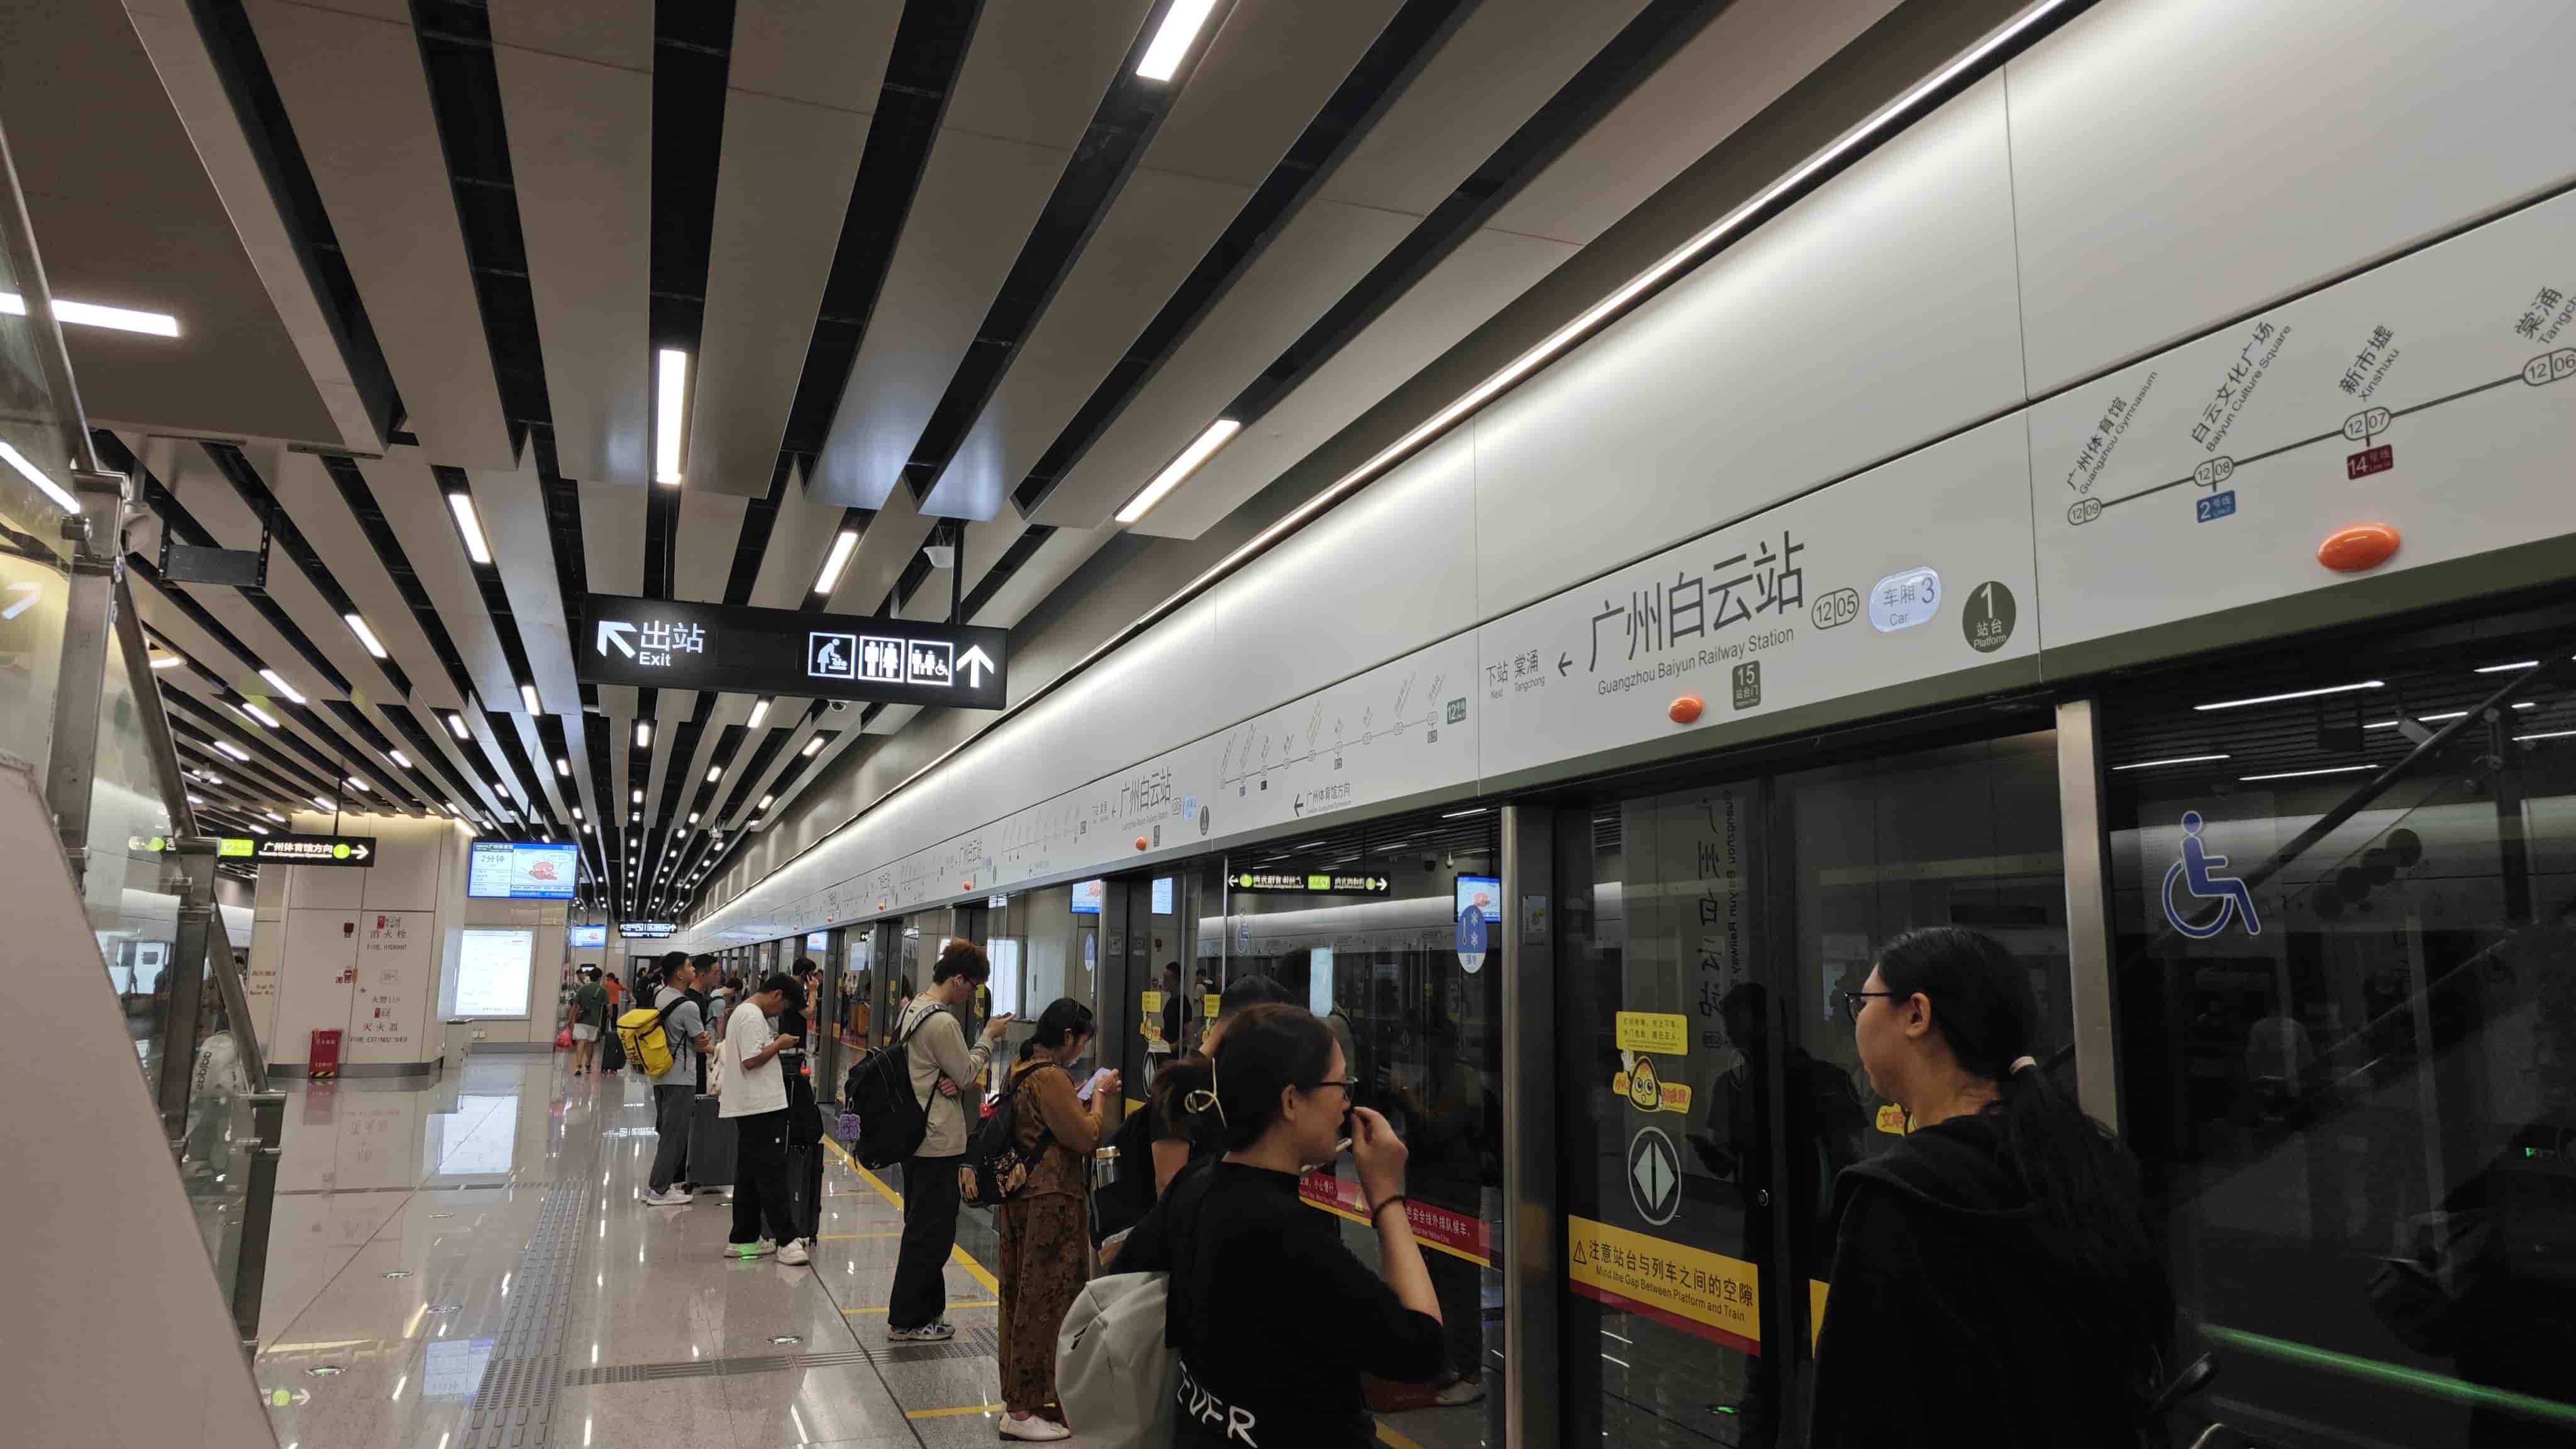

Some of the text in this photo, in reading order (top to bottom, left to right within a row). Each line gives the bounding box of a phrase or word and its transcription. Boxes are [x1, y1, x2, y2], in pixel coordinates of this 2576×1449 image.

[2514, 287, 2563, 340] 棠涌
[2339, 325, 2394, 396] 新市墟
[2358, 348, 2400, 402] Xinshixu
[2529, 354, 2576, 380] 12 06
[2192, 321, 2275, 443] 白云文化广场
[2206, 325, 2291, 453] Baiyun Culture Square
[2080, 371, 2158, 494] Guangzhou Gymnasium
[2348, 413, 2385, 435] 12 07
[2067, 397, 2126, 491] 广州体育馆
[2198, 461, 2231, 481] 12 08
[2349, 456, 2367, 475] 14
[2200, 501, 2211, 519] 2
[1589, 530, 1804, 673] 广州白云站
[1816, 594, 1855, 623] 12 05
[1884, 577, 1935, 608] 车厢 3
[1980, 582, 1993, 619] 1
[640, 620, 705, 653] 出站
[1889, 613, 1909, 626] Car
[1976, 618, 2002, 638] 站台
[1973, 634, 2007, 648] Platform
[639, 652, 671, 667] Exit
[1485, 649, 1539, 687] 下站 棠涌
[1598, 628, 1794, 696] Guangzhou Baiyun Railway Station
[1738, 665, 1756, 686] 15
[1120, 765, 1172, 818] 广州白云站
[263, 841, 333, 854] 广州体育馆方向
[1589, 1239, 1753, 1307] 注意站台与列车之间的空隙
[1596, 1265, 1745, 1322] Mind the Gap Between Platform and Train
